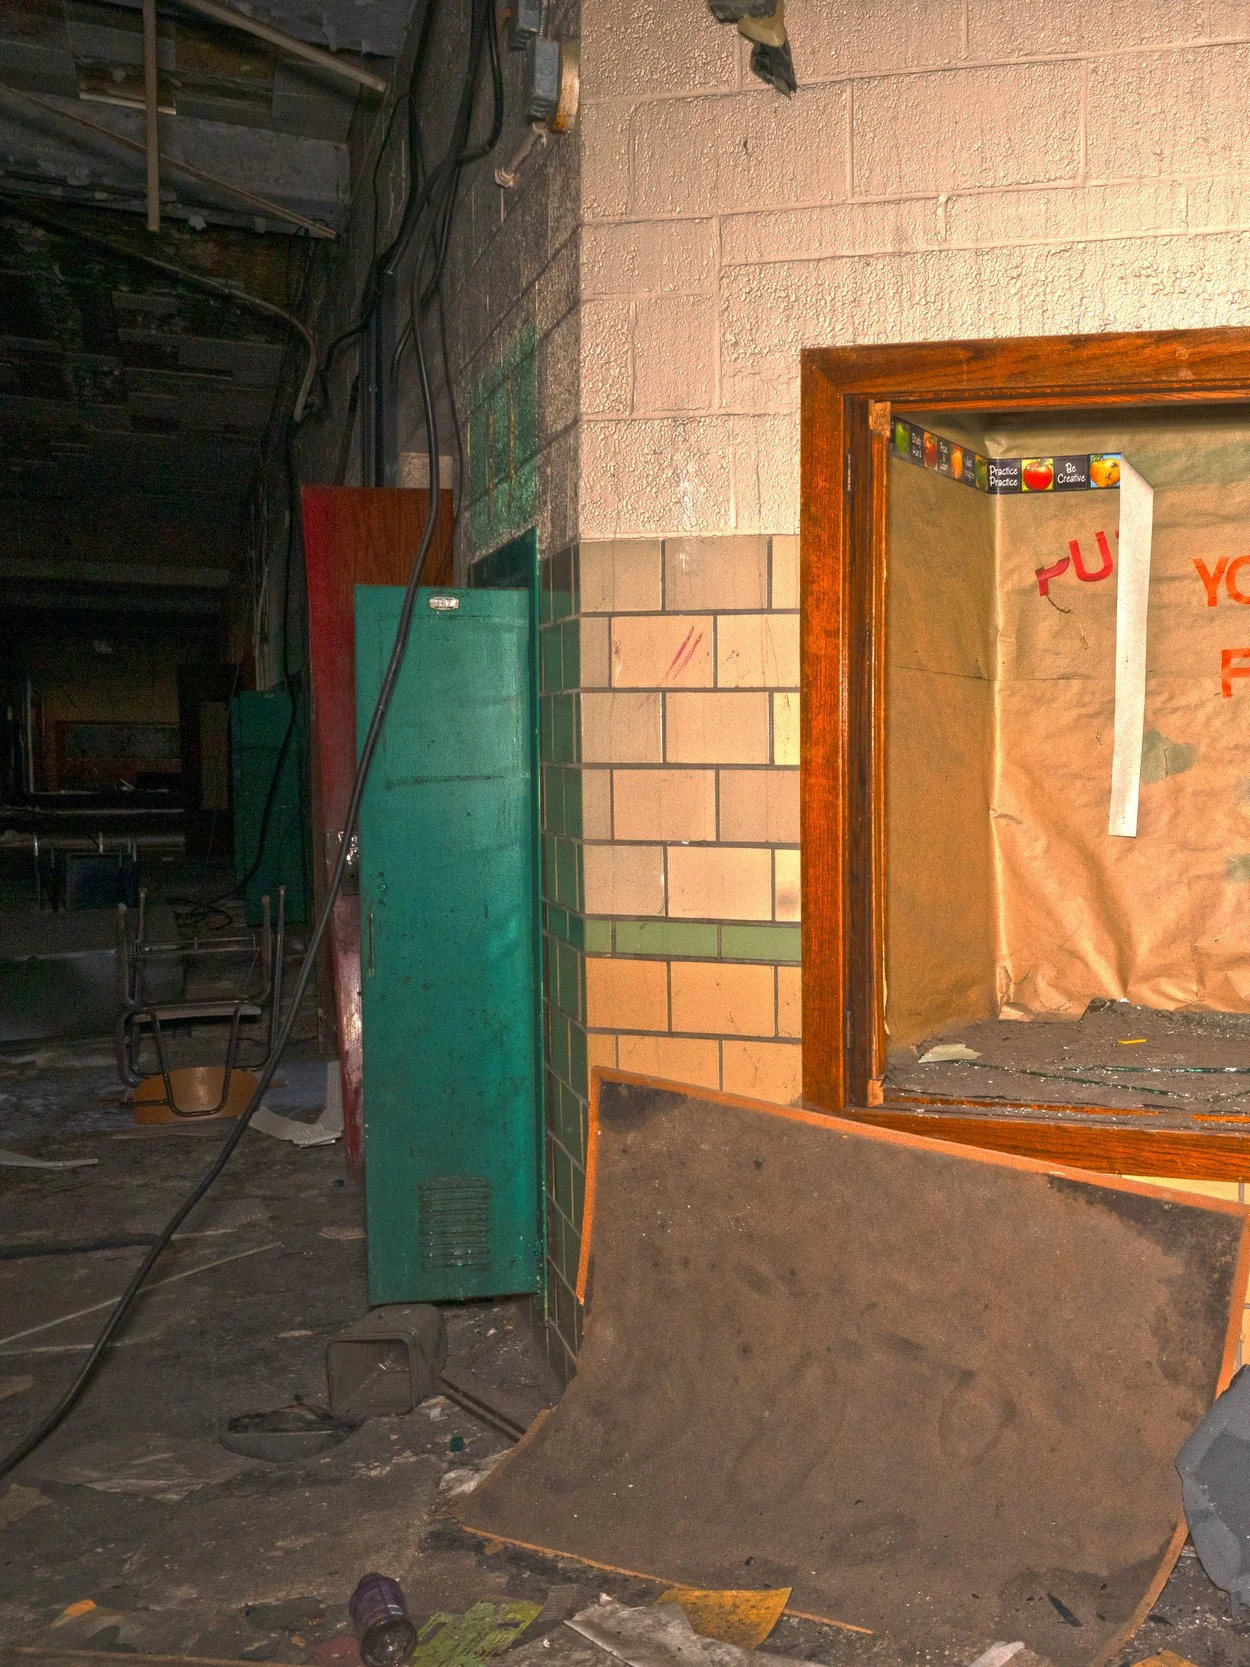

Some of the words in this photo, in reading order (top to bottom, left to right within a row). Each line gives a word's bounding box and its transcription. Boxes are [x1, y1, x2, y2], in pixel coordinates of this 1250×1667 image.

[989, 465, 1018, 476] Practice
[1065, 462, 1077, 474] Be
[989, 476, 1018, 487] Practice
[1057, 473, 1086, 484] Creative
